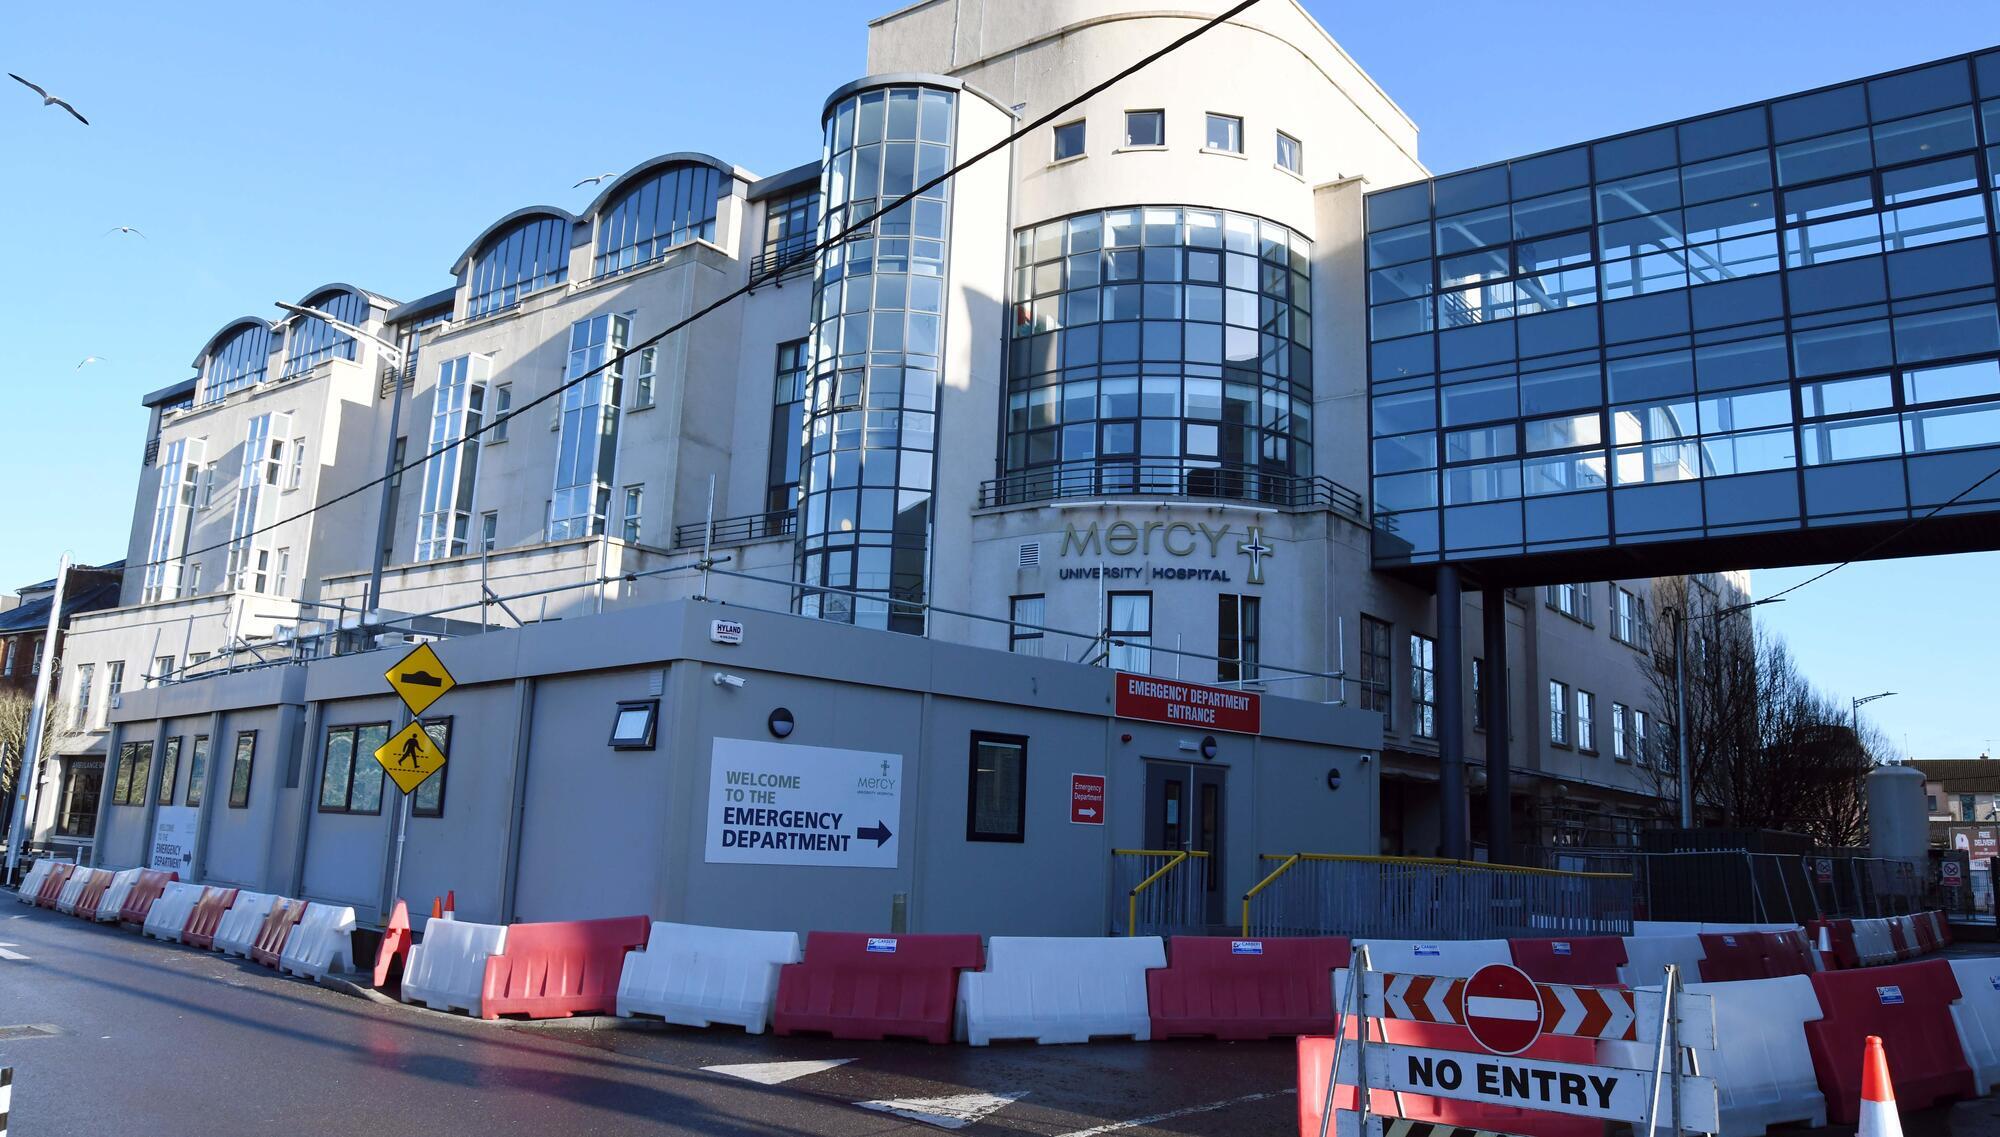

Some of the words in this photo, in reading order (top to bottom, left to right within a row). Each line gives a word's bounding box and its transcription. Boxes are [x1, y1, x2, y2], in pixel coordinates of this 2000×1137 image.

[1059, 567, 1142, 580] UNIVERSITY
[1152, 568, 1231, 582] HOSPITAL
[717, 623, 741, 634] HYLAND
[1128, 679, 1188, 702] EMERGENCY
[1190, 689, 1249, 711] DEPARTMENT
[1167, 703, 1215, 723] ENTRANCE
[726, 770, 800, 789] WELCOME
[1074, 782, 1102, 793] Emergency
[725, 788, 744, 802] TO
[749, 790, 776, 804] THE
[1074, 792, 1102, 801] Department
[723, 806, 843, 830] EMERGENCY
[722, 829, 851, 852] DEPARTMENT
[156, 843, 182, 856] EMERGENCY
[154, 855, 181, 869] DEPARTMENT
[1408, 1055, 1463, 1091] NO
[1476, 1062, 1619, 1110] ENTRY
